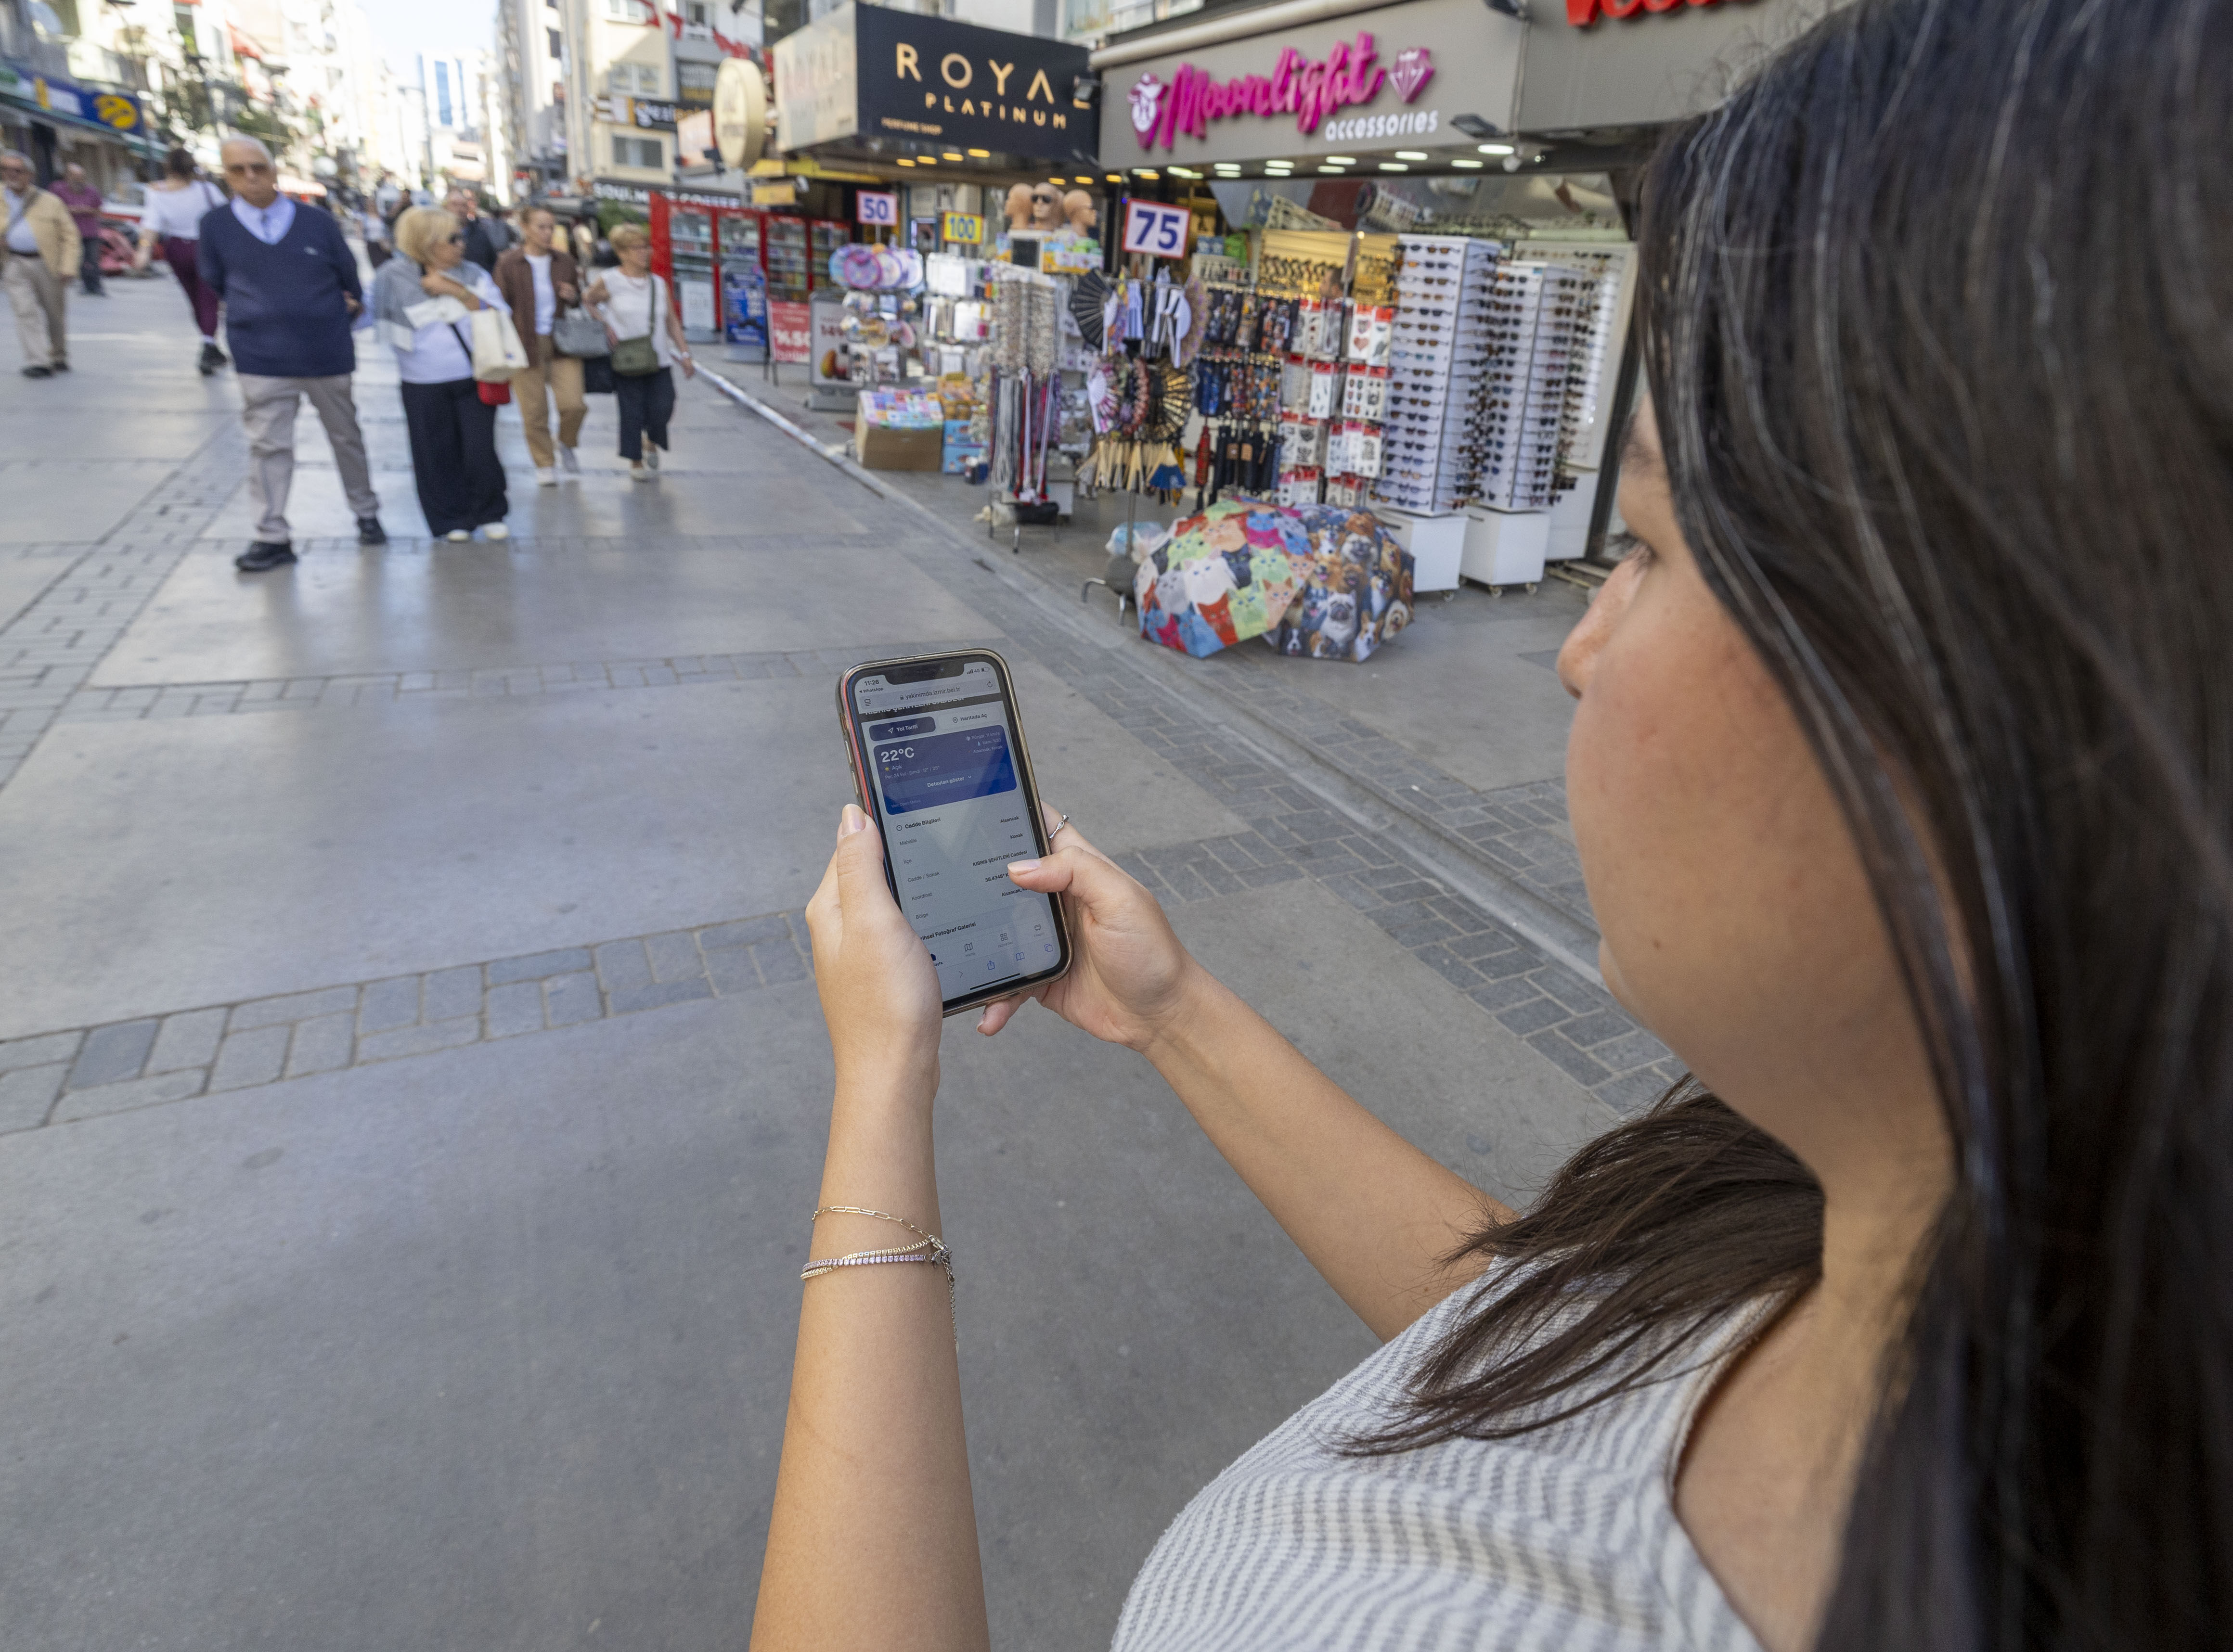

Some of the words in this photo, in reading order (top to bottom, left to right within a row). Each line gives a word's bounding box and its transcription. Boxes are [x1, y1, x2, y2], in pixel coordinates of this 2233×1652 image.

[1160, 30, 1385, 149] Moonlight
[925, 92, 1067, 129] PLATINUM
[1325, 110, 1439, 141] accessories
[864, 197, 888, 219] 50
[949, 216, 975, 239] 100
[1136, 210, 1179, 249] 75
[905, 687, 960, 700] yakinimda.izmir.bel.tr
[880, 747, 915, 763] 22°C
[922, 817, 941, 826] Bilgileri
[988, 853, 1010, 864] ŞEHİTLERİ
[985, 873, 1005, 883] 38.4348°
[911, 892, 932, 901] Koordinat
[1001, 888, 1022, 897] Alsancak,
[935, 927, 957, 937] Fotoğraf
[957, 921, 977, 931] Galerisi
